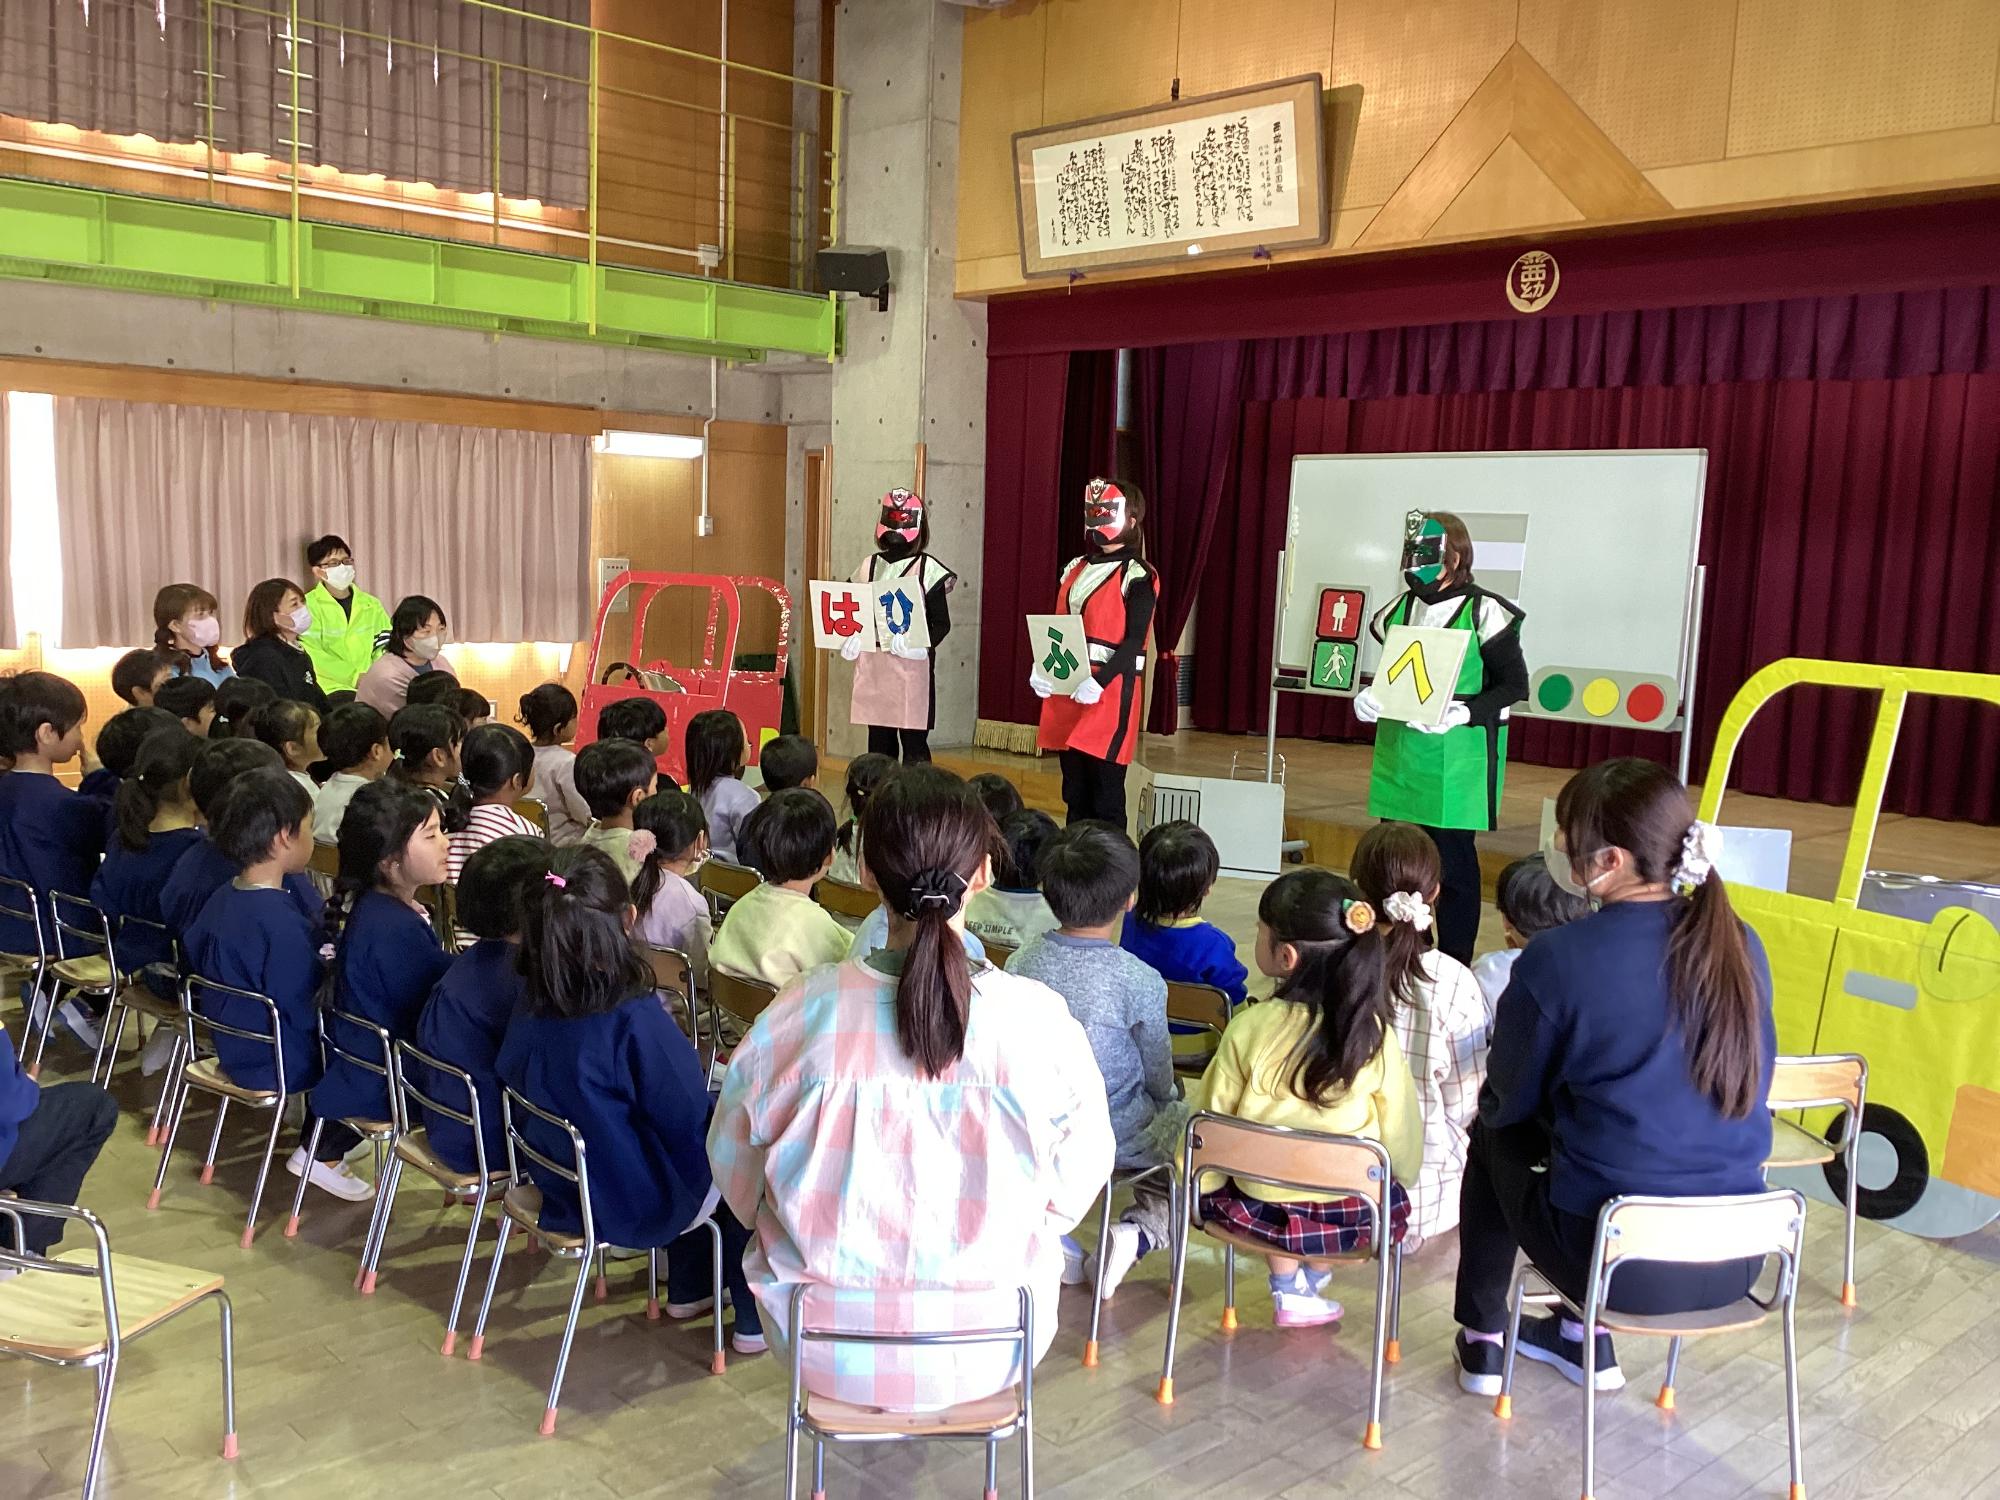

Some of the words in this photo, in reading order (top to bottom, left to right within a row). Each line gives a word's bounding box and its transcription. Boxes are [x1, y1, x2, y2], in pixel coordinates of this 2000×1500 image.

[821, 590, 863, 637] は
[879, 587, 914, 635] ひ
[1042, 626, 1079, 680] ふ
[1387, 640, 1434, 705] へ
[984, 924, 1013, 935] SIMPLE
